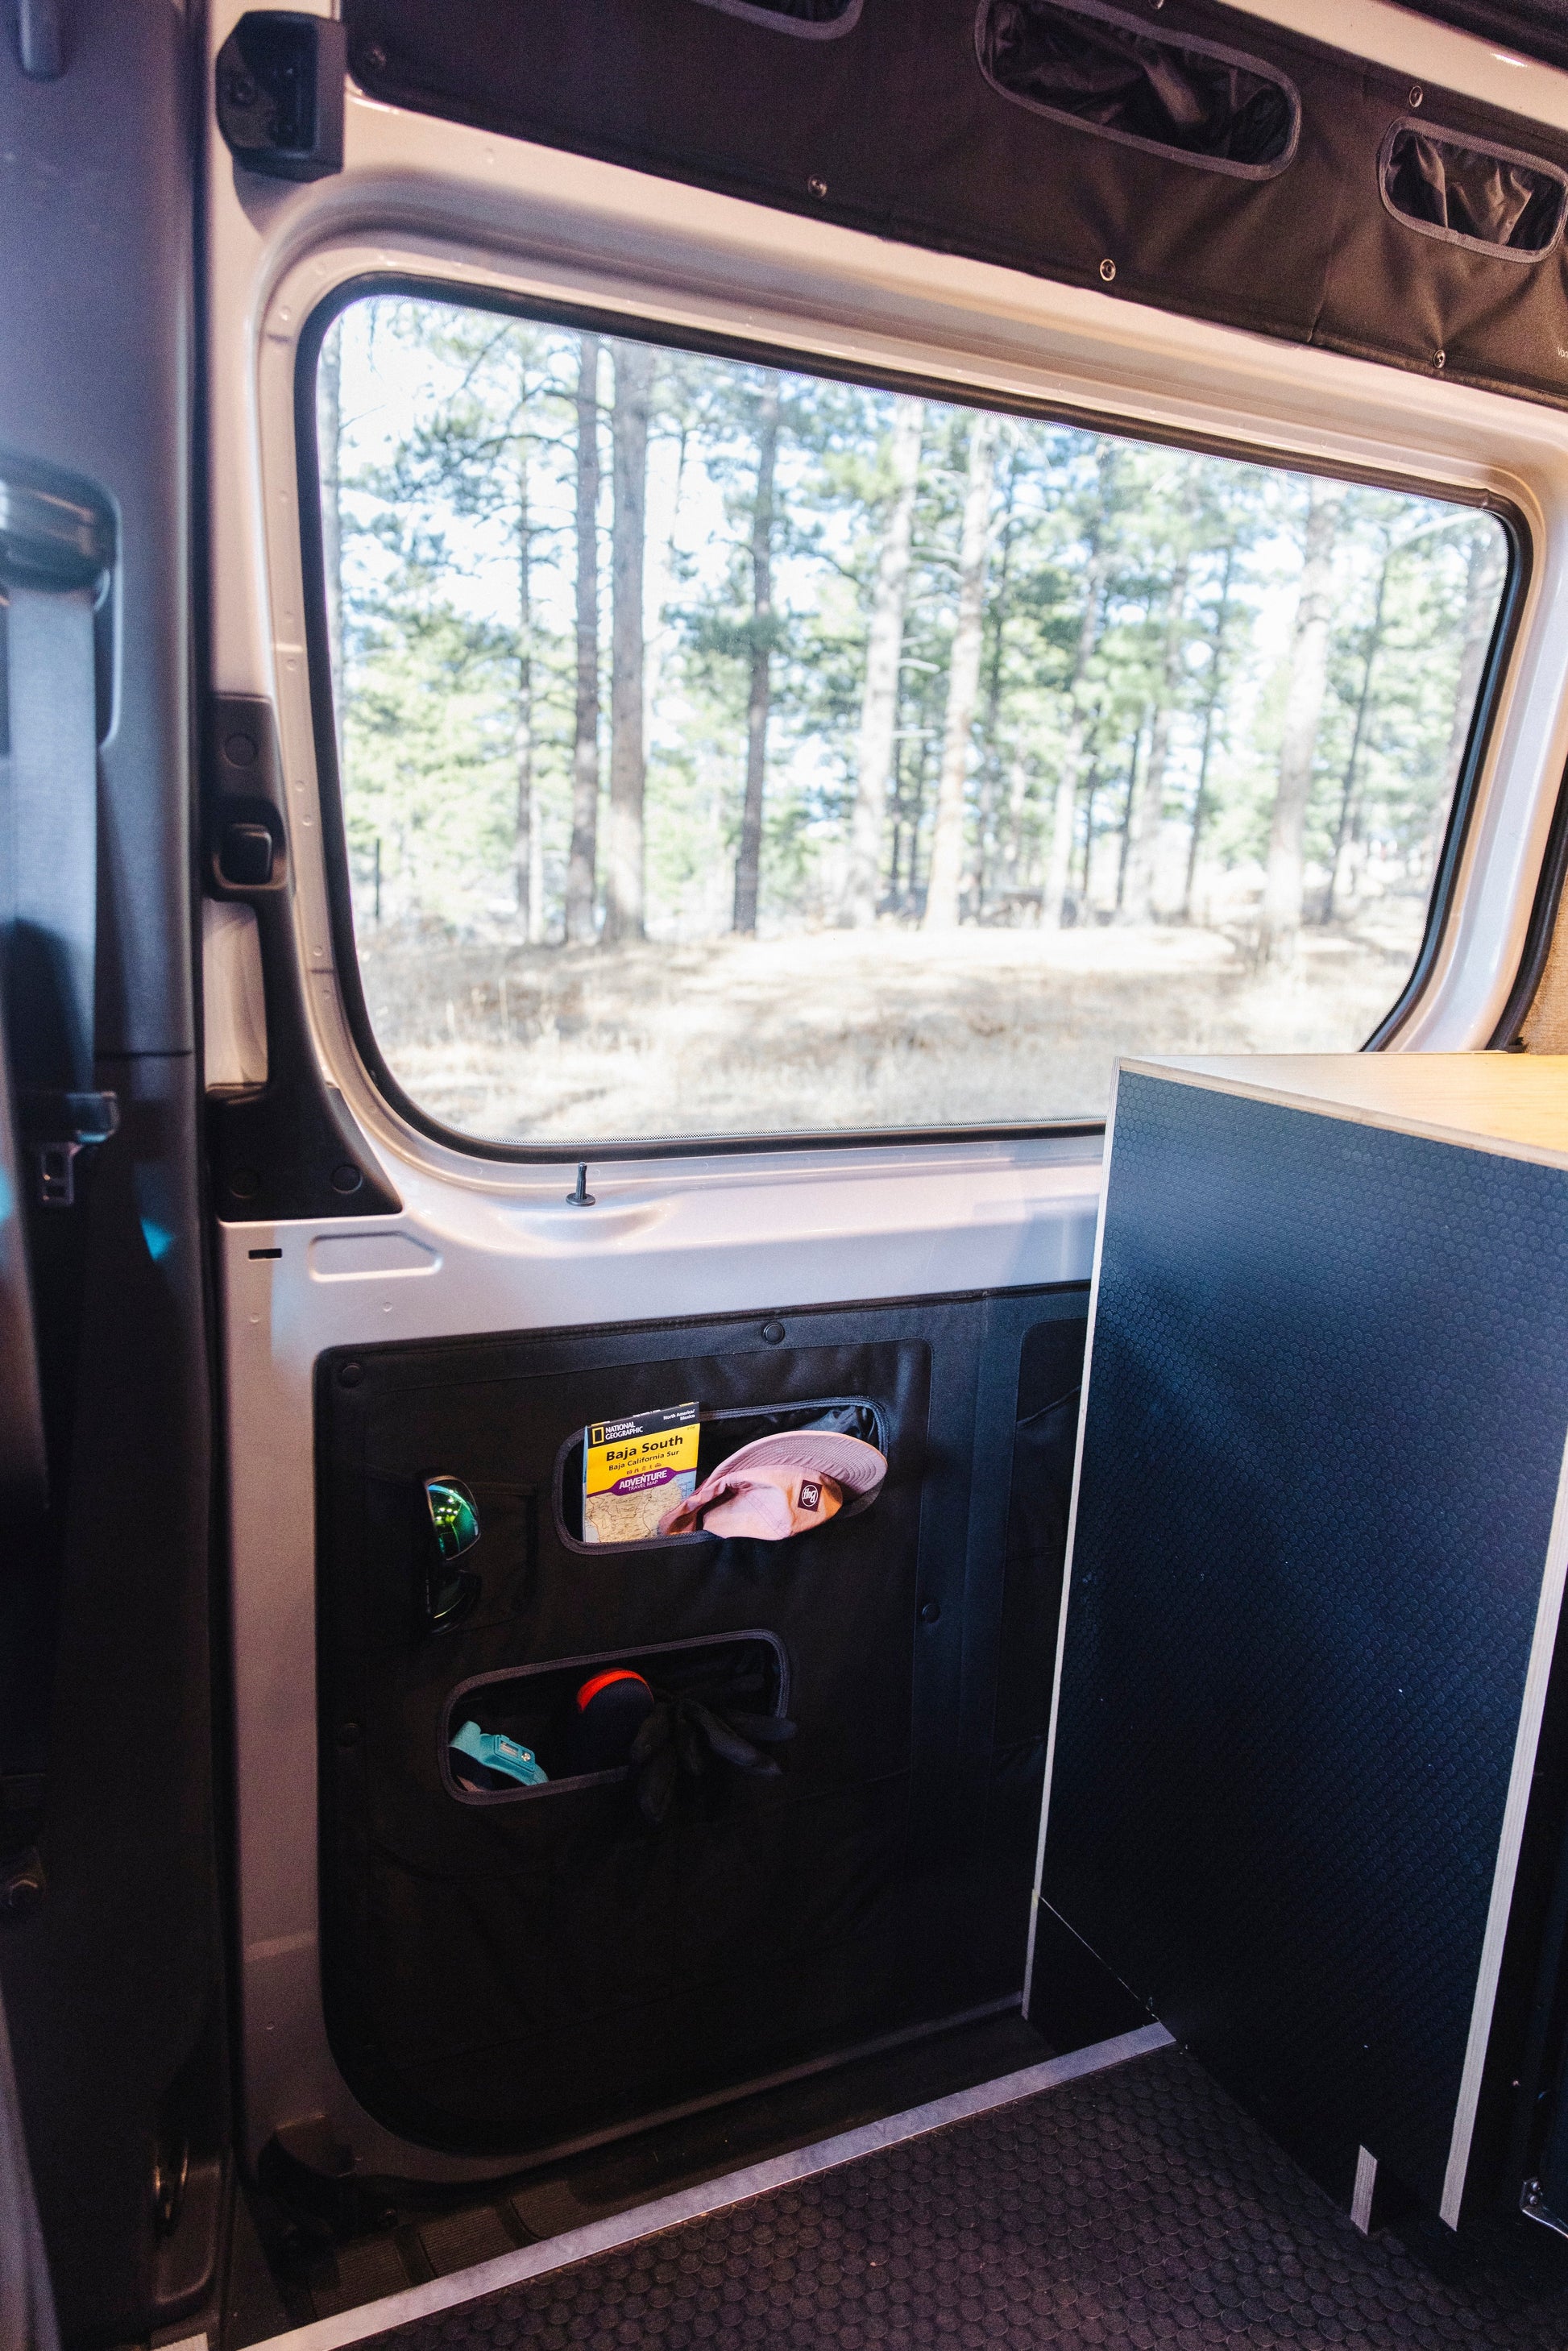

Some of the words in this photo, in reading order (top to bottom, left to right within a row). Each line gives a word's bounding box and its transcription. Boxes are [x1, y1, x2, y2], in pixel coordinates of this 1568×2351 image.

[605, 1421, 636, 1433] NATIONAL
[605, 1425, 644, 1441] GEOGRAPHIC
[606, 1447, 637, 1462] Baja
[641, 1435, 683, 1453] South
[608, 1462, 625, 1471] Baja
[627, 1453, 665, 1466] California
[666, 1449, 679, 1457] Sur
[619, 1470, 668, 1490] ADVENTURE
[628, 1483, 646, 1491] TRAVEL
